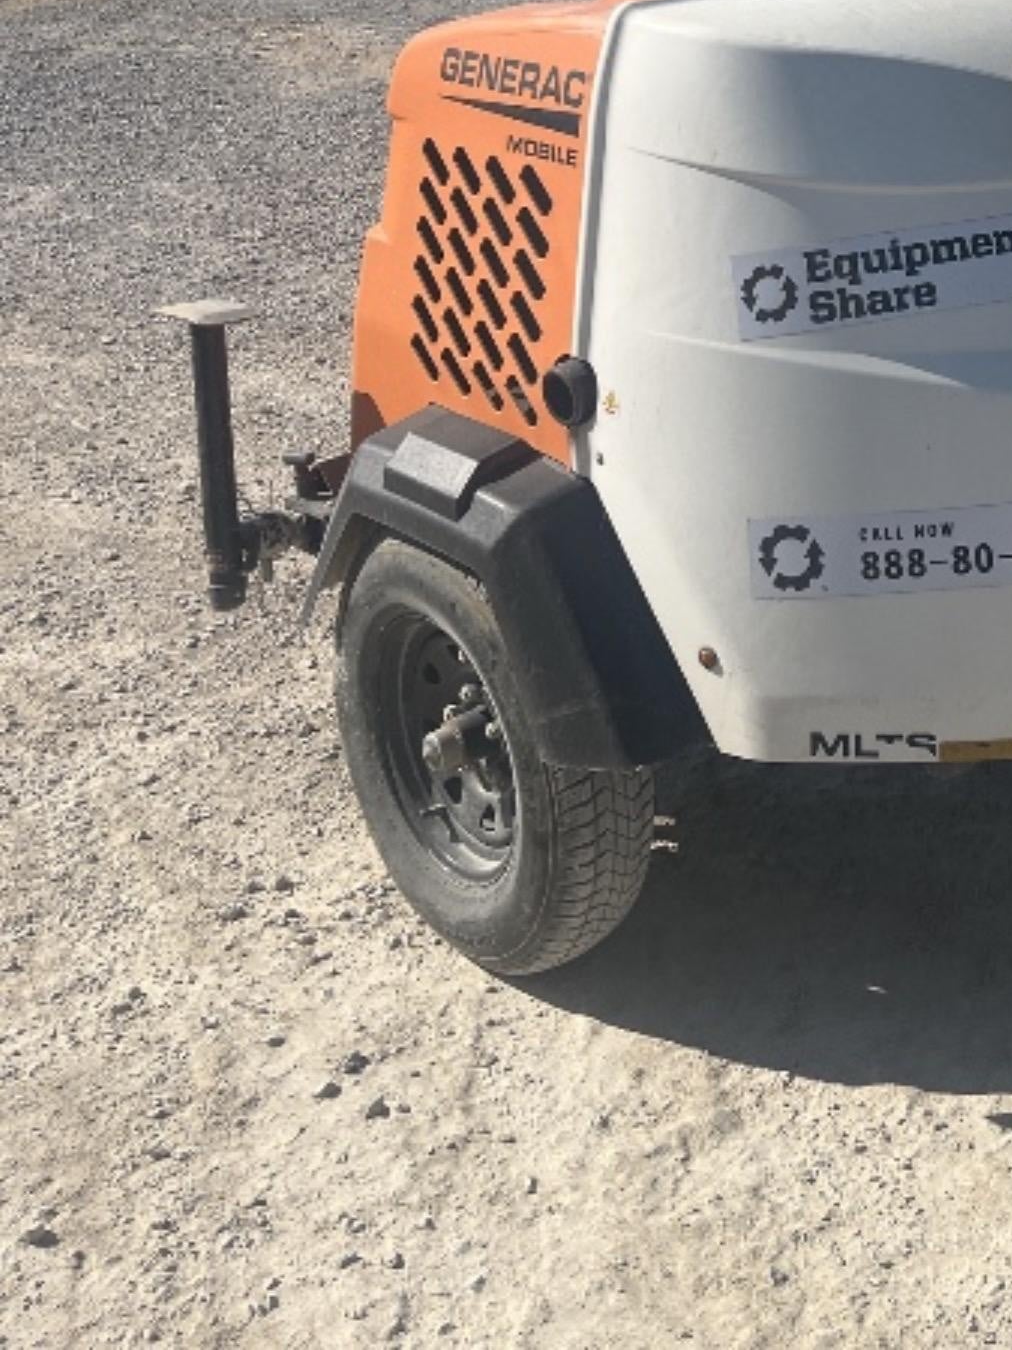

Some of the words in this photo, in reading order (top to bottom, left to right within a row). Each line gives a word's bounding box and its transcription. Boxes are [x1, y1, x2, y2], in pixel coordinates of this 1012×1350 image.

[440, 47, 586, 108] GENERAC
[507, 134, 579, 168] MOBILE
[809, 281, 937, 324] Share
[859, 526, 904, 542] CALL
[914, 521, 954, 539] NOW
